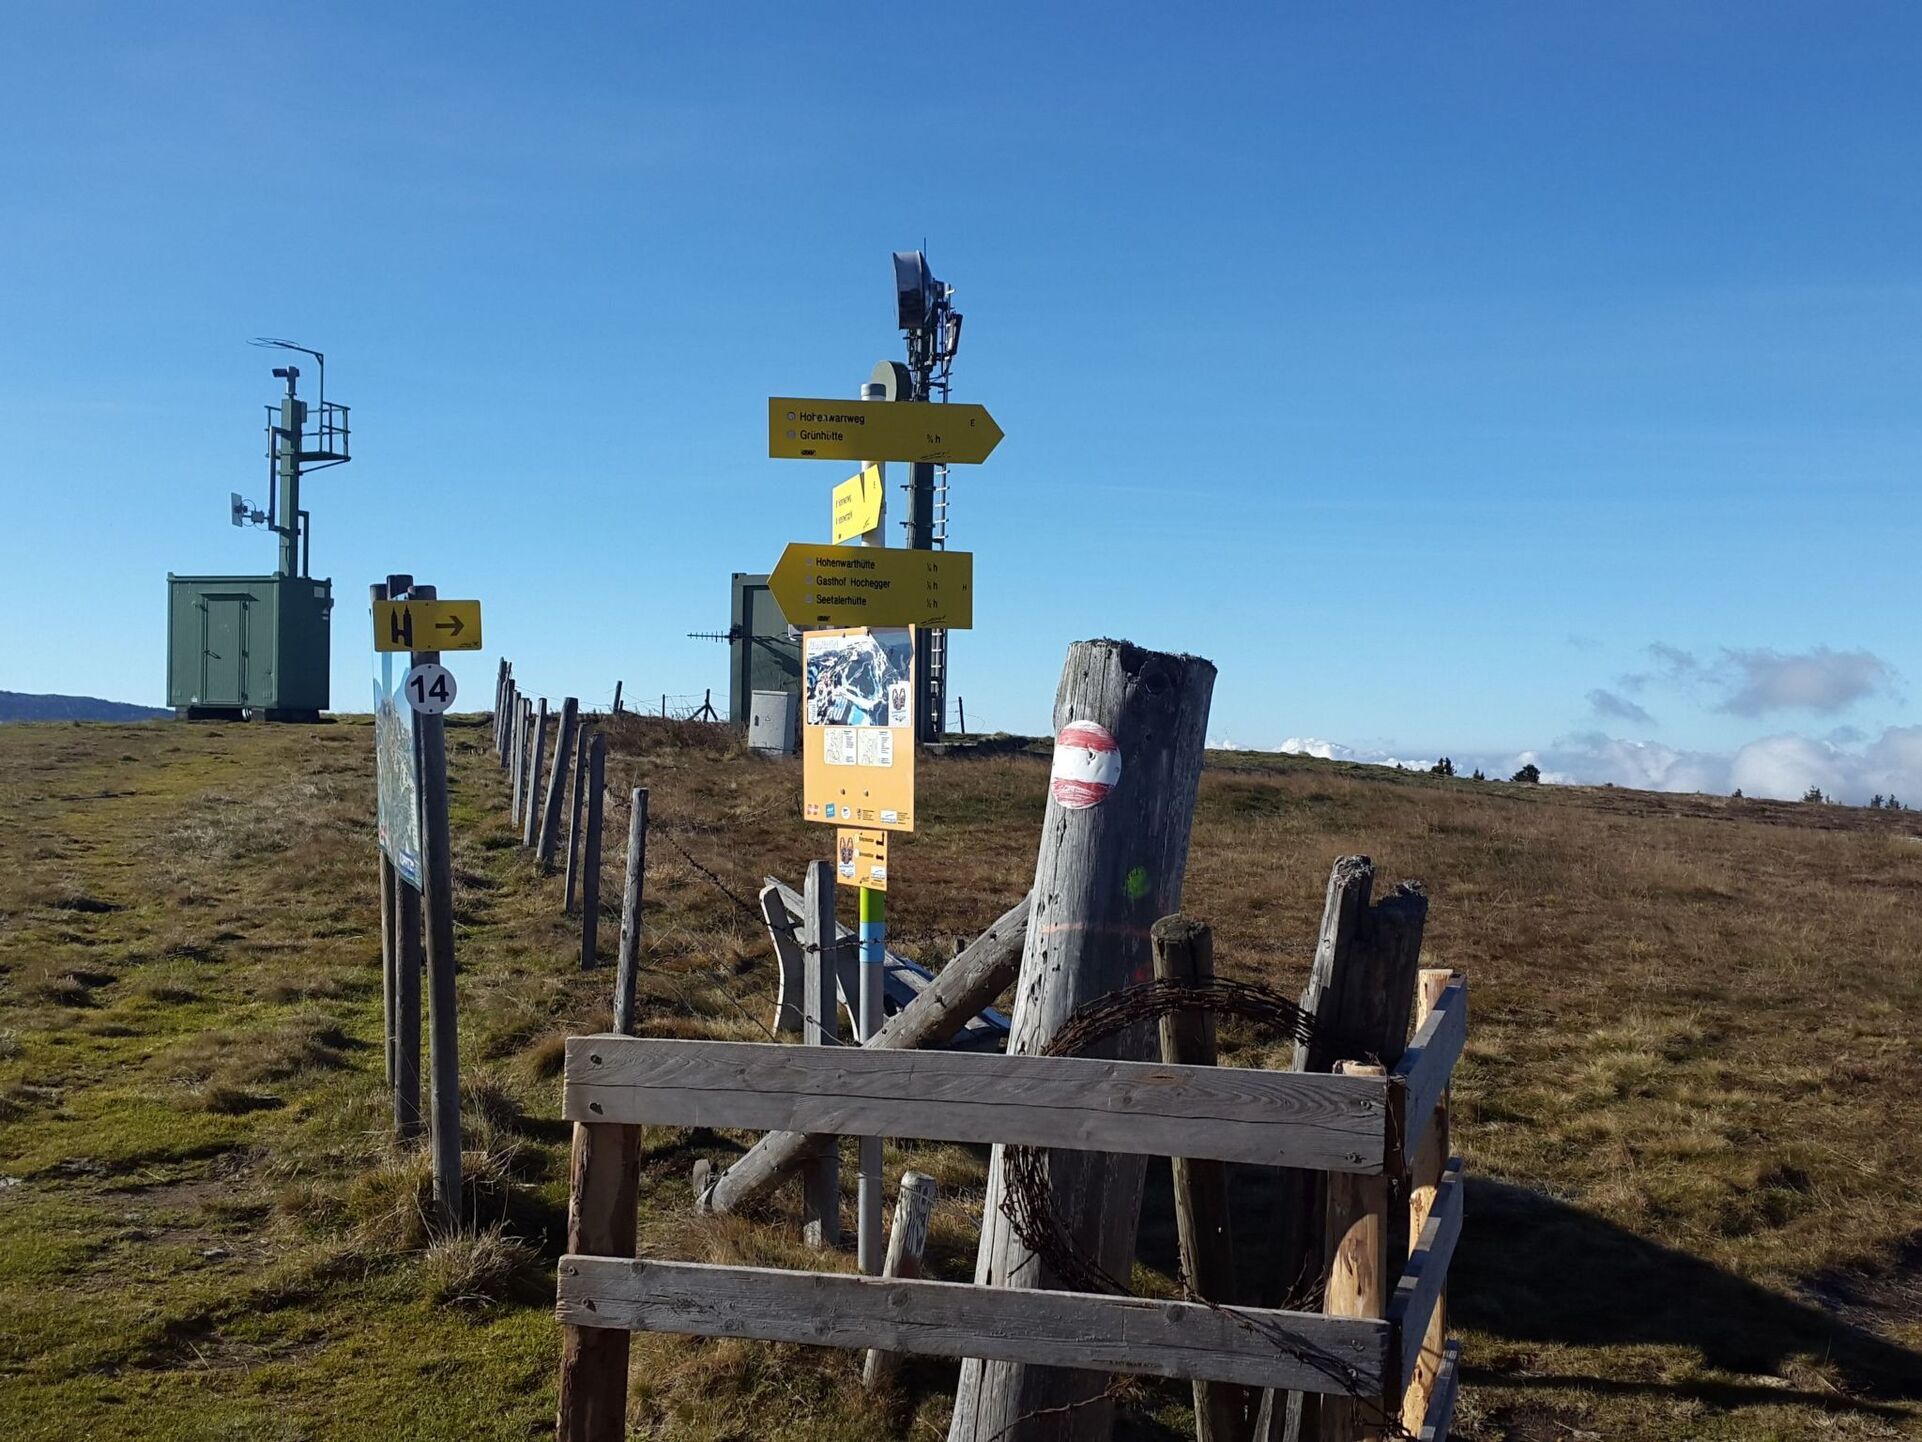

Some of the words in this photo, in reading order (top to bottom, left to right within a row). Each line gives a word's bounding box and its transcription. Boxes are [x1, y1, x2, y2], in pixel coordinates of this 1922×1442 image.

[816, 557, 876, 570] Hohenwarthütte
[816, 575, 847, 587] Gasthof
[850, 577, 891, 590] Hochegger
[816, 594, 867, 606] Seetalerhütte
[411, 674, 450, 704] 14
